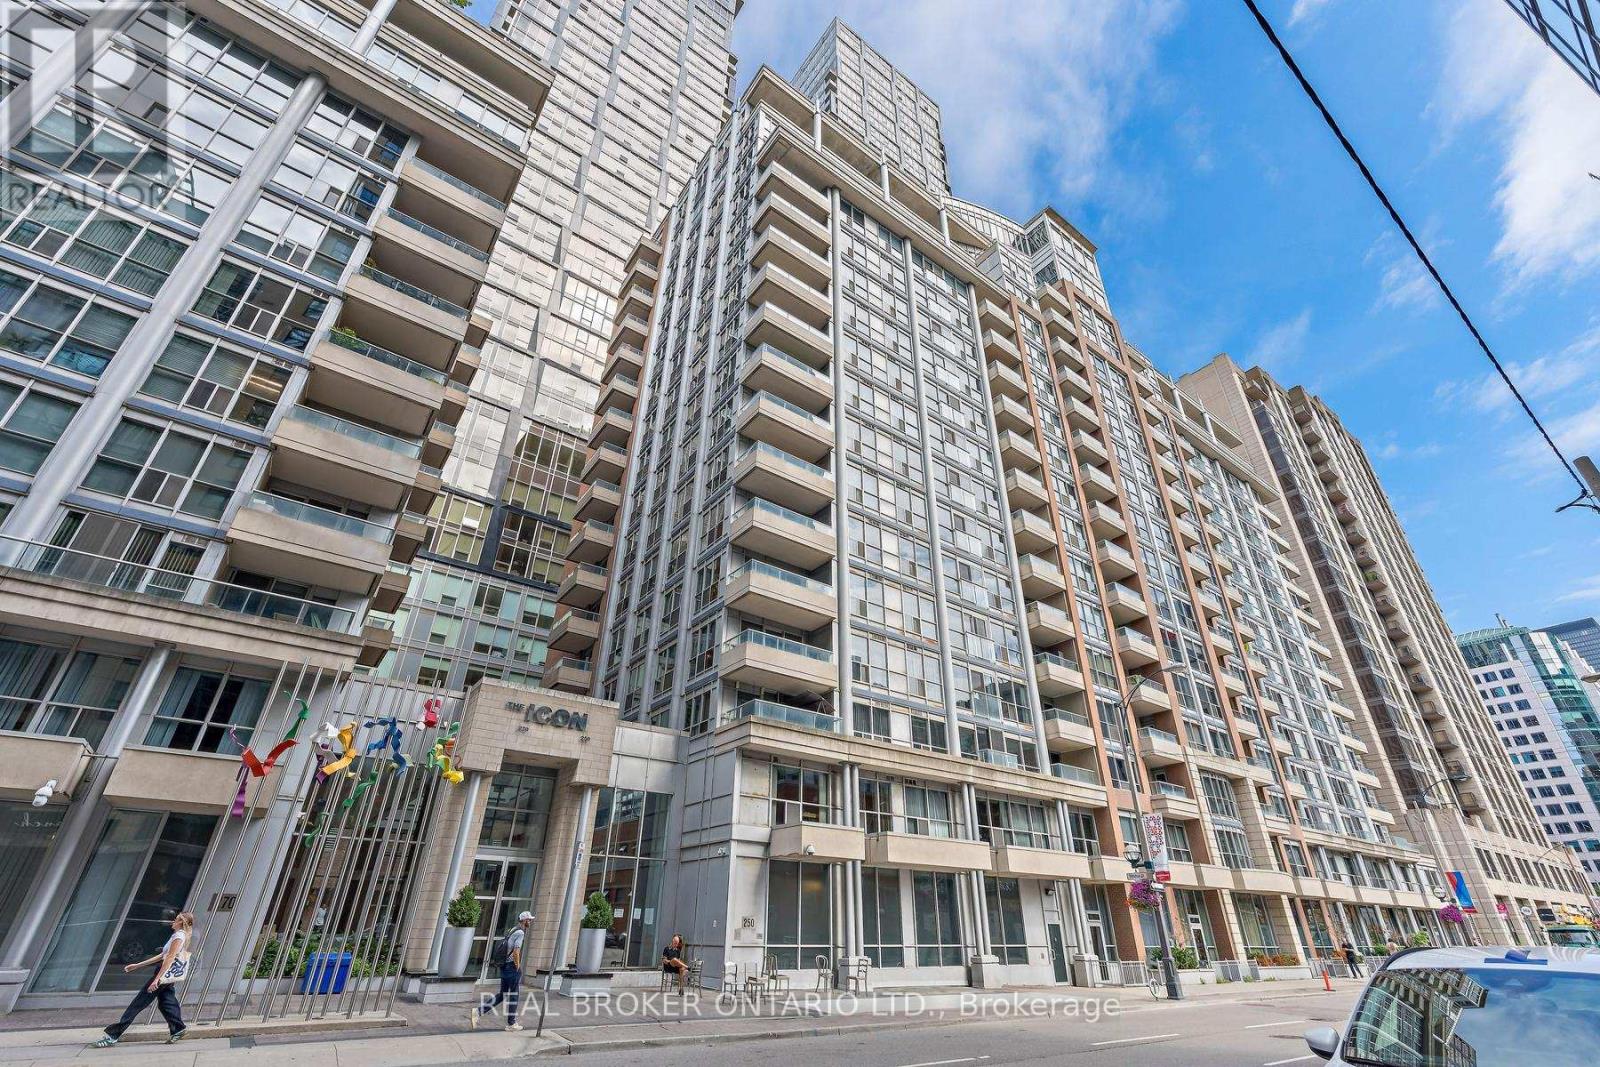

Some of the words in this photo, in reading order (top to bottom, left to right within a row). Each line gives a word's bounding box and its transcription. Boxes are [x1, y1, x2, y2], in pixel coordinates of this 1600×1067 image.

[505, 701, 525, 712] THE
[525, 704, 588, 731] ICON
[743, 918, 755, 928] 250
